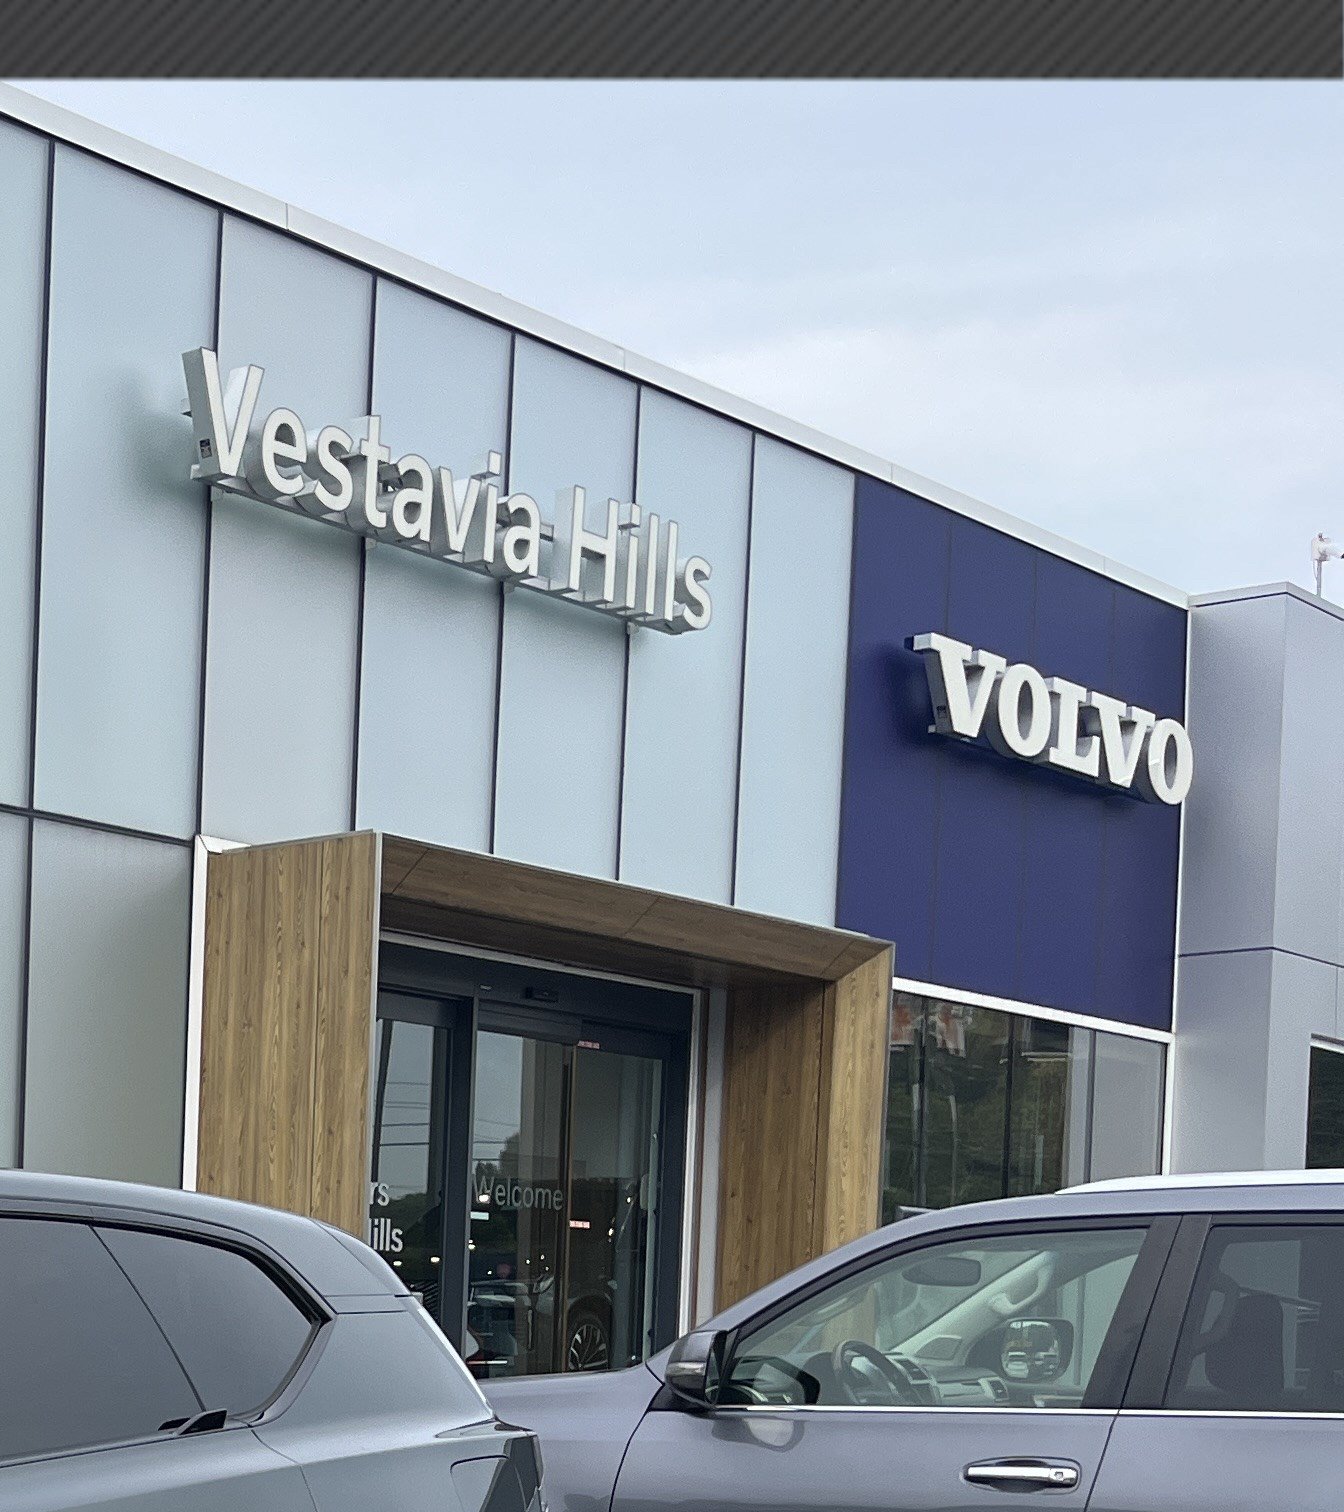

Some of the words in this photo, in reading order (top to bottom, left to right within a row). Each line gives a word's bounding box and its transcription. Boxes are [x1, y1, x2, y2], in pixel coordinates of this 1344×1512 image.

[184, 346, 540, 578] Vestavia
[567, 485, 713, 632] Hills
[912, 632, 1193, 805] VOLVO
[471, 1174, 564, 1210] Welcome
